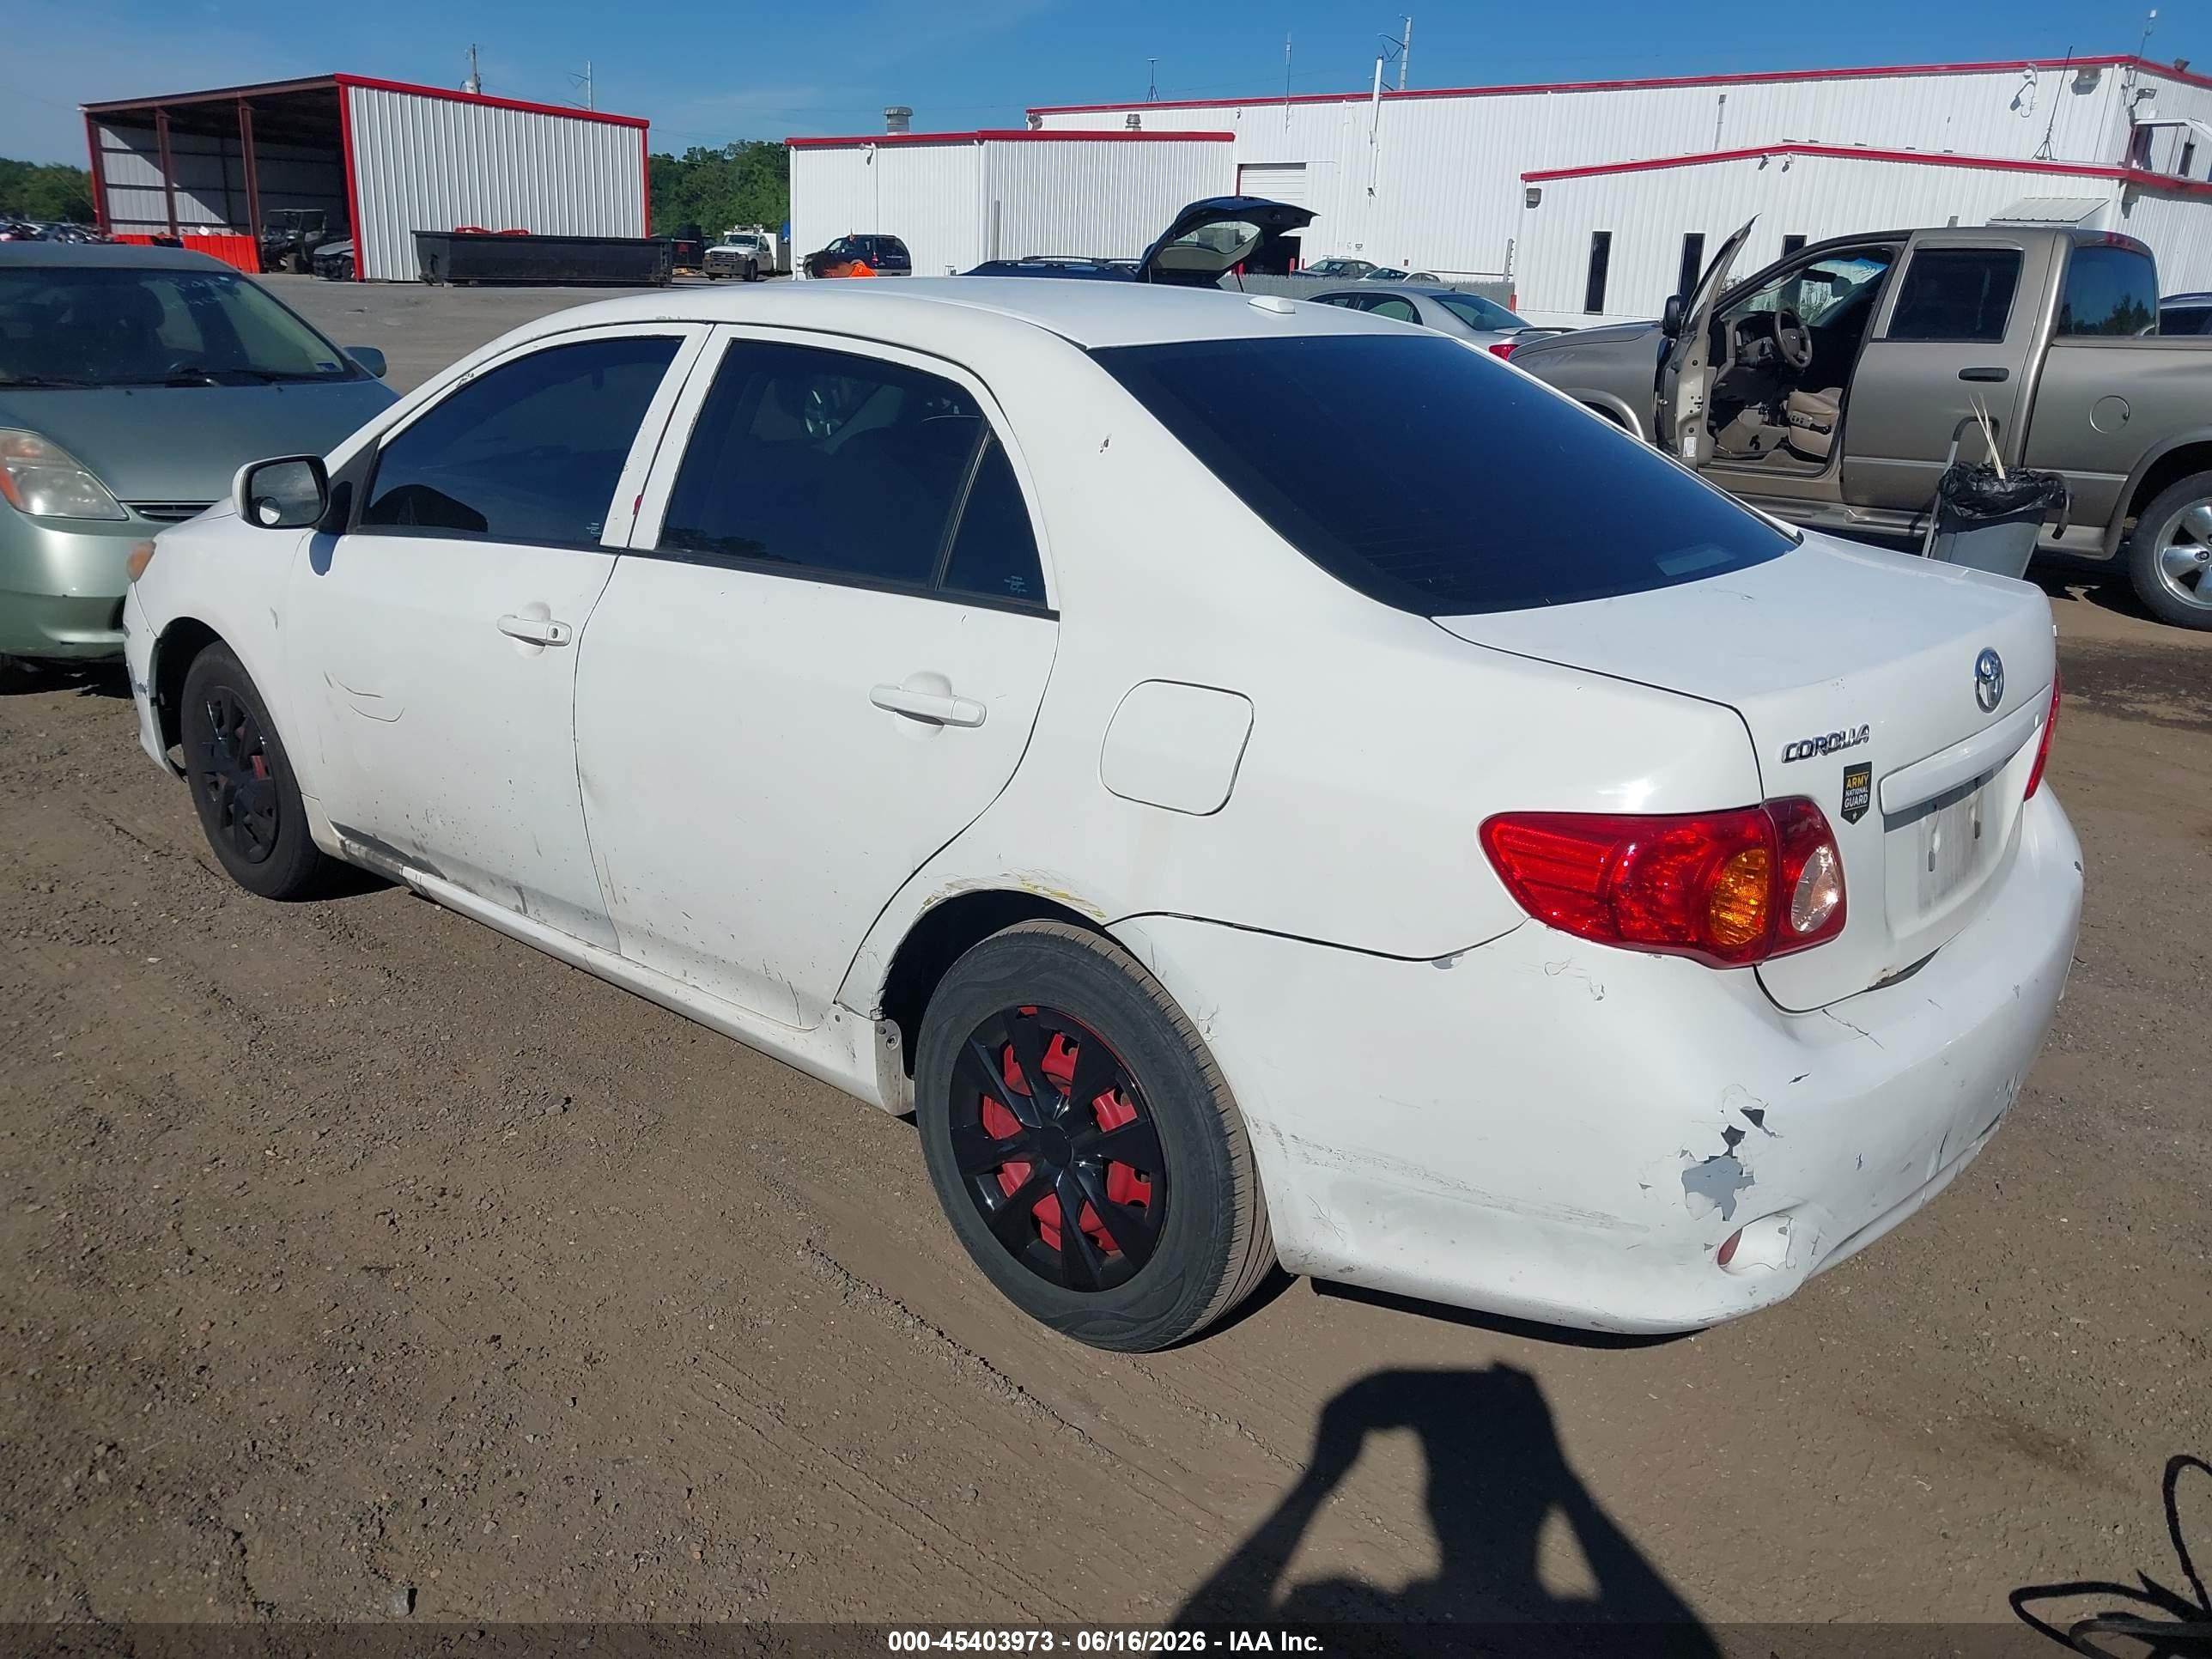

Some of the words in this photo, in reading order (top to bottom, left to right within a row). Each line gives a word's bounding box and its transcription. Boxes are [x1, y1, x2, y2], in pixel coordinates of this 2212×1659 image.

[1782, 724, 1870, 763] COROLLA
[1846, 774, 1869, 789] ARMY
[1844, 786, 1869, 798] NATIONAL
[1844, 793, 1869, 808] GUARD
